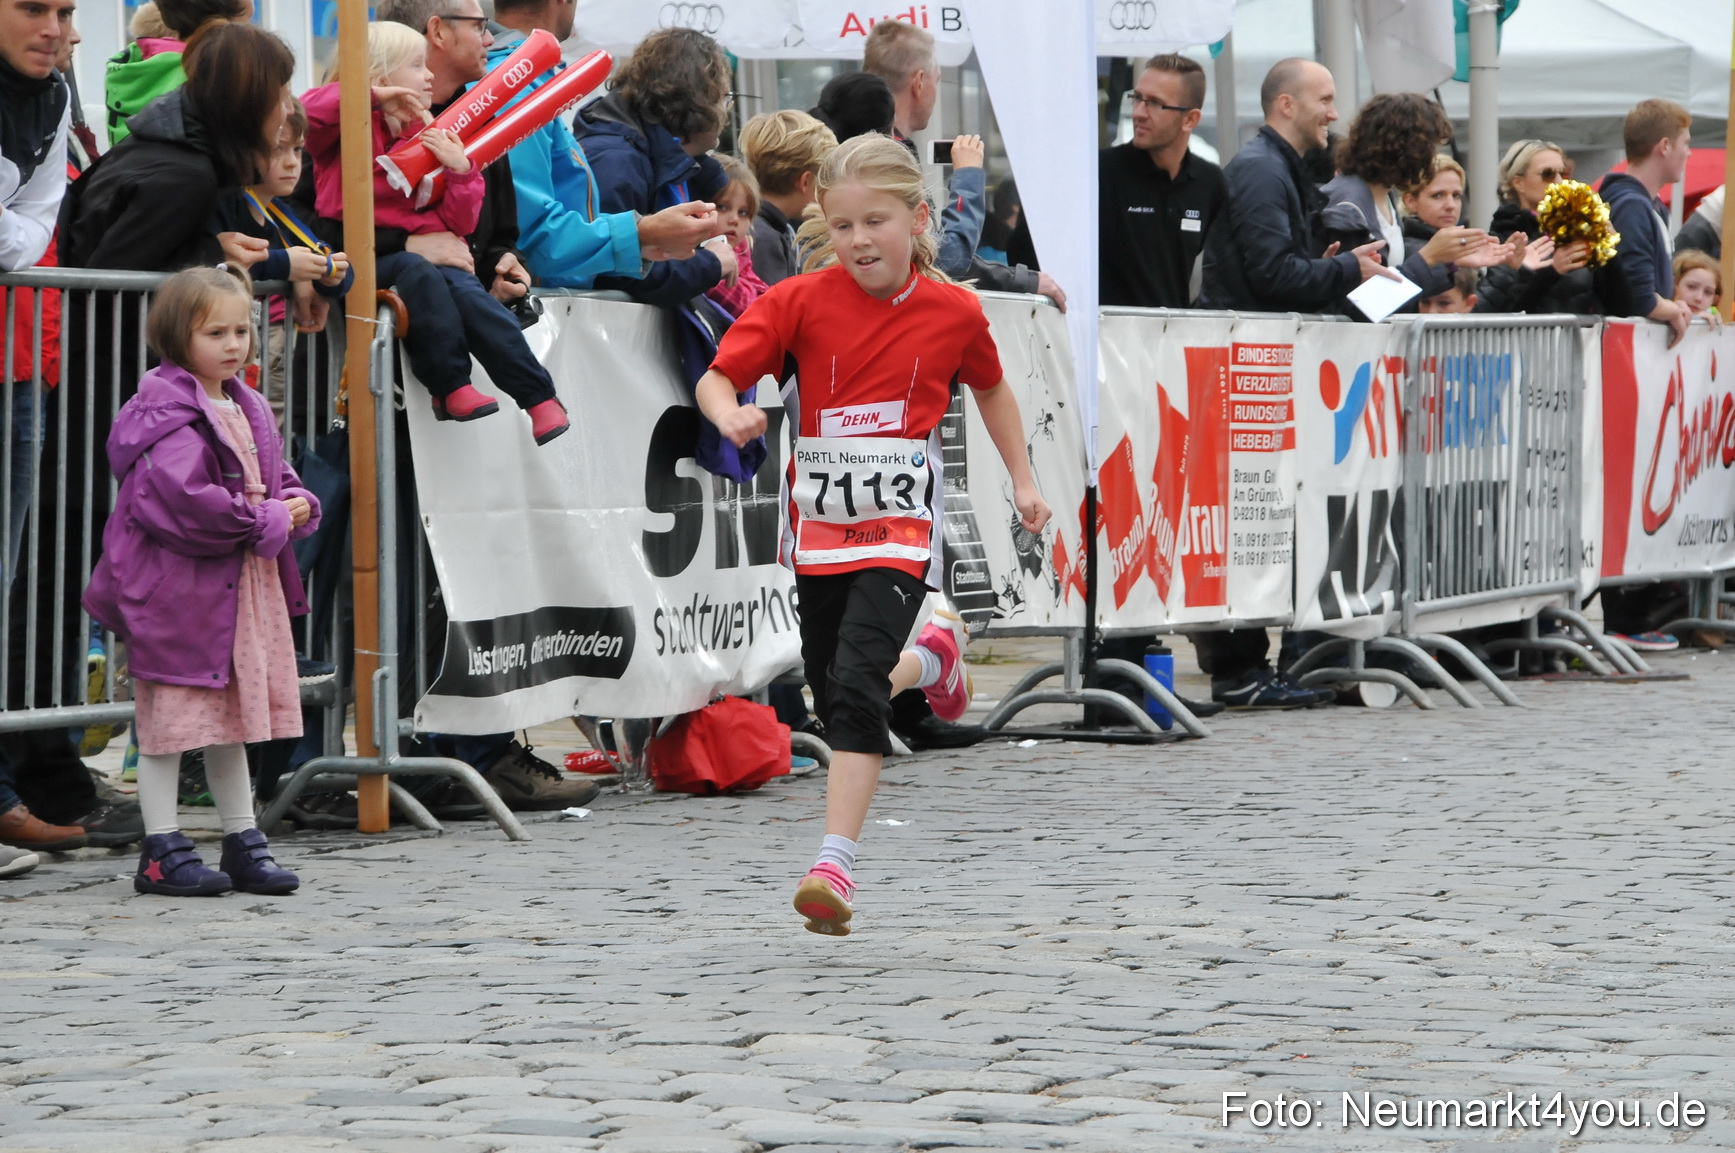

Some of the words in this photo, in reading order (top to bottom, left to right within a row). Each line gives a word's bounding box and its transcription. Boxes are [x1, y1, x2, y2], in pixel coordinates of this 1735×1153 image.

[468, 88, 499, 117] BKK
[841, 411, 880, 428] DEHN
[797, 451, 836, 464] PARTL
[839, 452, 906, 465] Neumarkt
[1234, 468, 1260, 484] Braun
[808, 471, 917, 518] 7113
[843, 524, 889, 545] Paula
[1110, 514, 1144, 587] Braun
